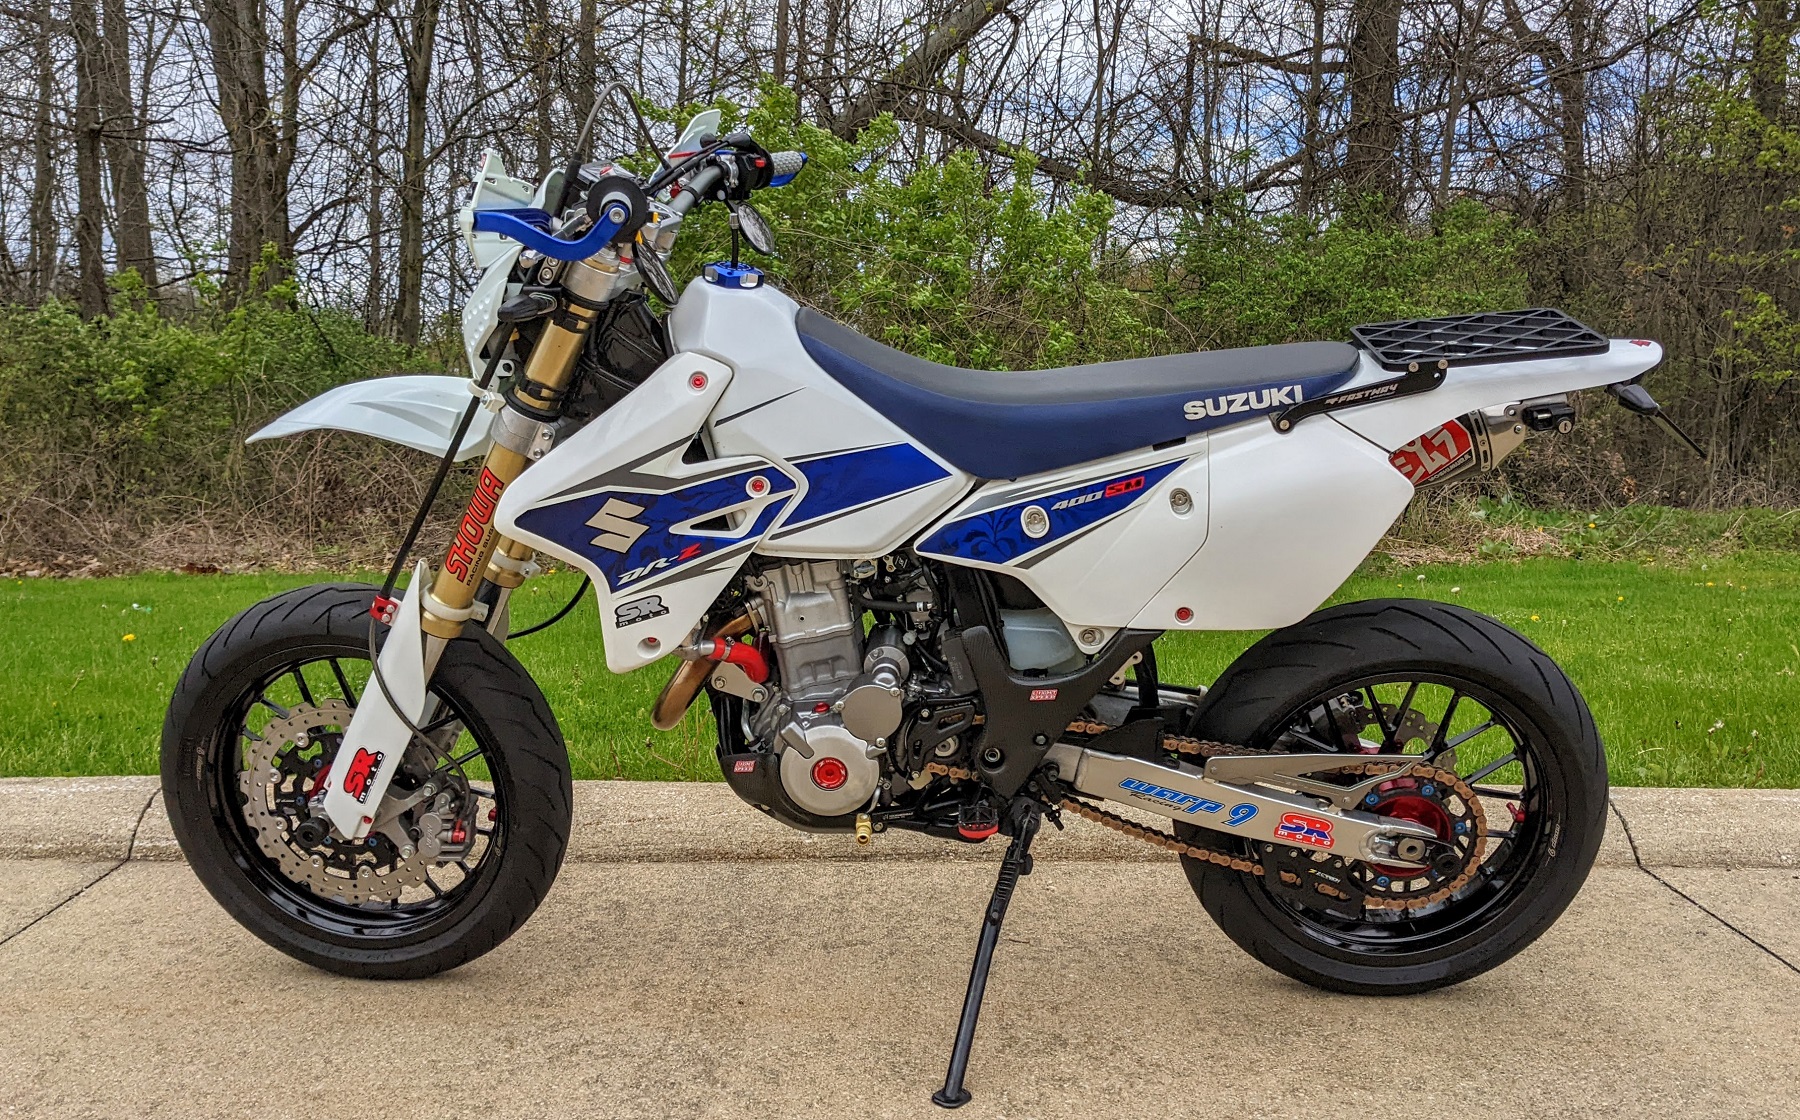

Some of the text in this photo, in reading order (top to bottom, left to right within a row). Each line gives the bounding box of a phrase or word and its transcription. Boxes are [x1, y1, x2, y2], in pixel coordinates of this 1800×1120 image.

[1184, 384, 1303, 421] SUZUKI
[1051, 476, 1145, 511] 400 SM
[445, 466, 505, 583] SHOWA
[466, 551, 484, 586] RACING
[616, 543, 702, 587] DR-Z
[614, 595, 670, 623] SR
[618, 610, 669, 628] moto
[343, 747, 378, 800] SR
[358, 753, 383, 802] moto
[1129, 790, 1182, 811] Racing
[1220, 803, 1259, 827] 9
[1277, 830, 1331, 846] moto
[1279, 813, 1332, 841] SR
